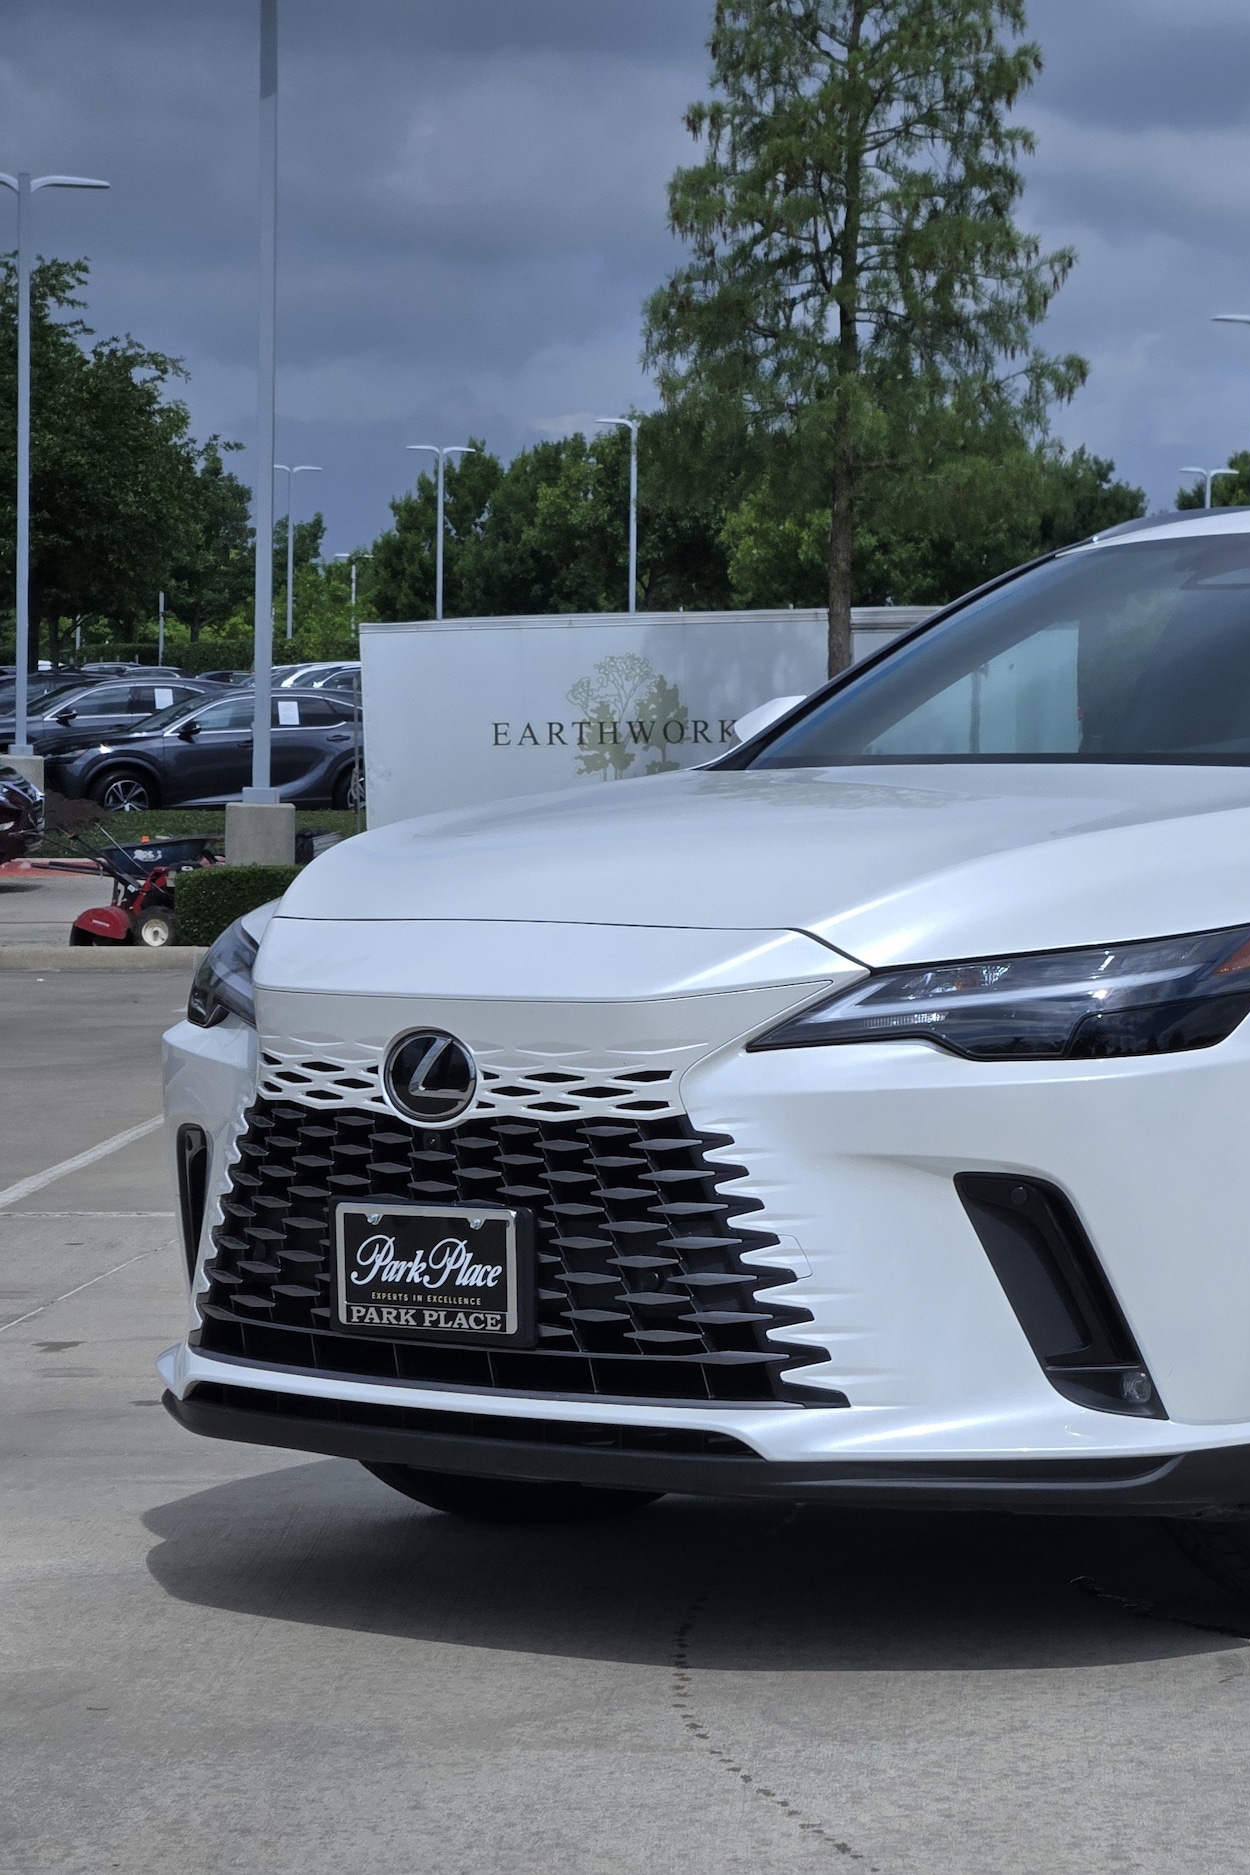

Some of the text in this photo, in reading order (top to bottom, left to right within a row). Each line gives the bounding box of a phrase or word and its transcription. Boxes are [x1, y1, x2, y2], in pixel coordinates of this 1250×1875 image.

[350, 1234, 502, 1289] Park Place
[371, 1291, 482, 1306] EXPERTS IN EXCELLENCE
[350, 1305, 502, 1331] PARK PLACE
